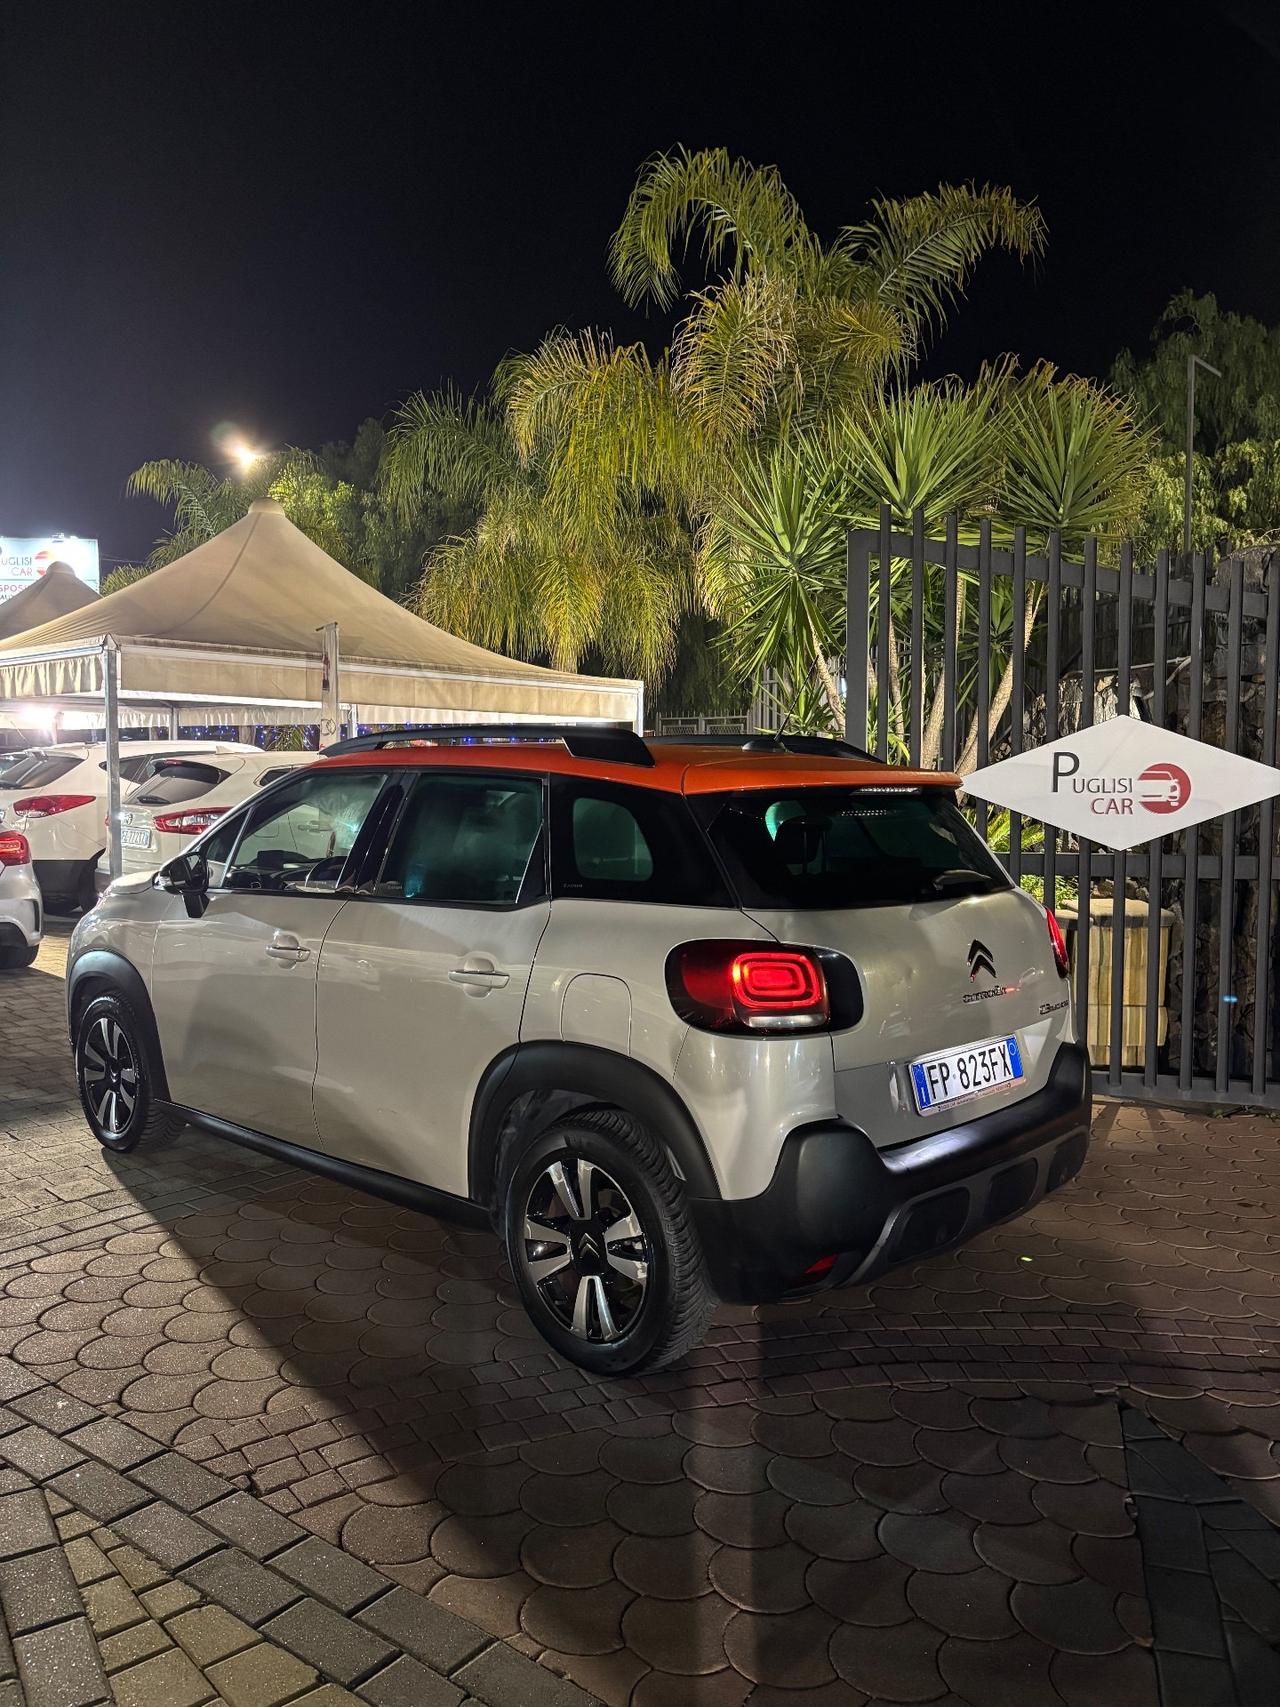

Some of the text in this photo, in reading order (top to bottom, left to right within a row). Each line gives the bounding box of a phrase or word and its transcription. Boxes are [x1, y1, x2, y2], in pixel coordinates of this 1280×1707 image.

[11, 567, 33, 577] CAR
[1052, 751, 1133, 793] PUGLISI
[1091, 798, 1133, 815] CAR
[926, 1062, 950, 1100] FP
[957, 1044, 1012, 1090] 823FX
